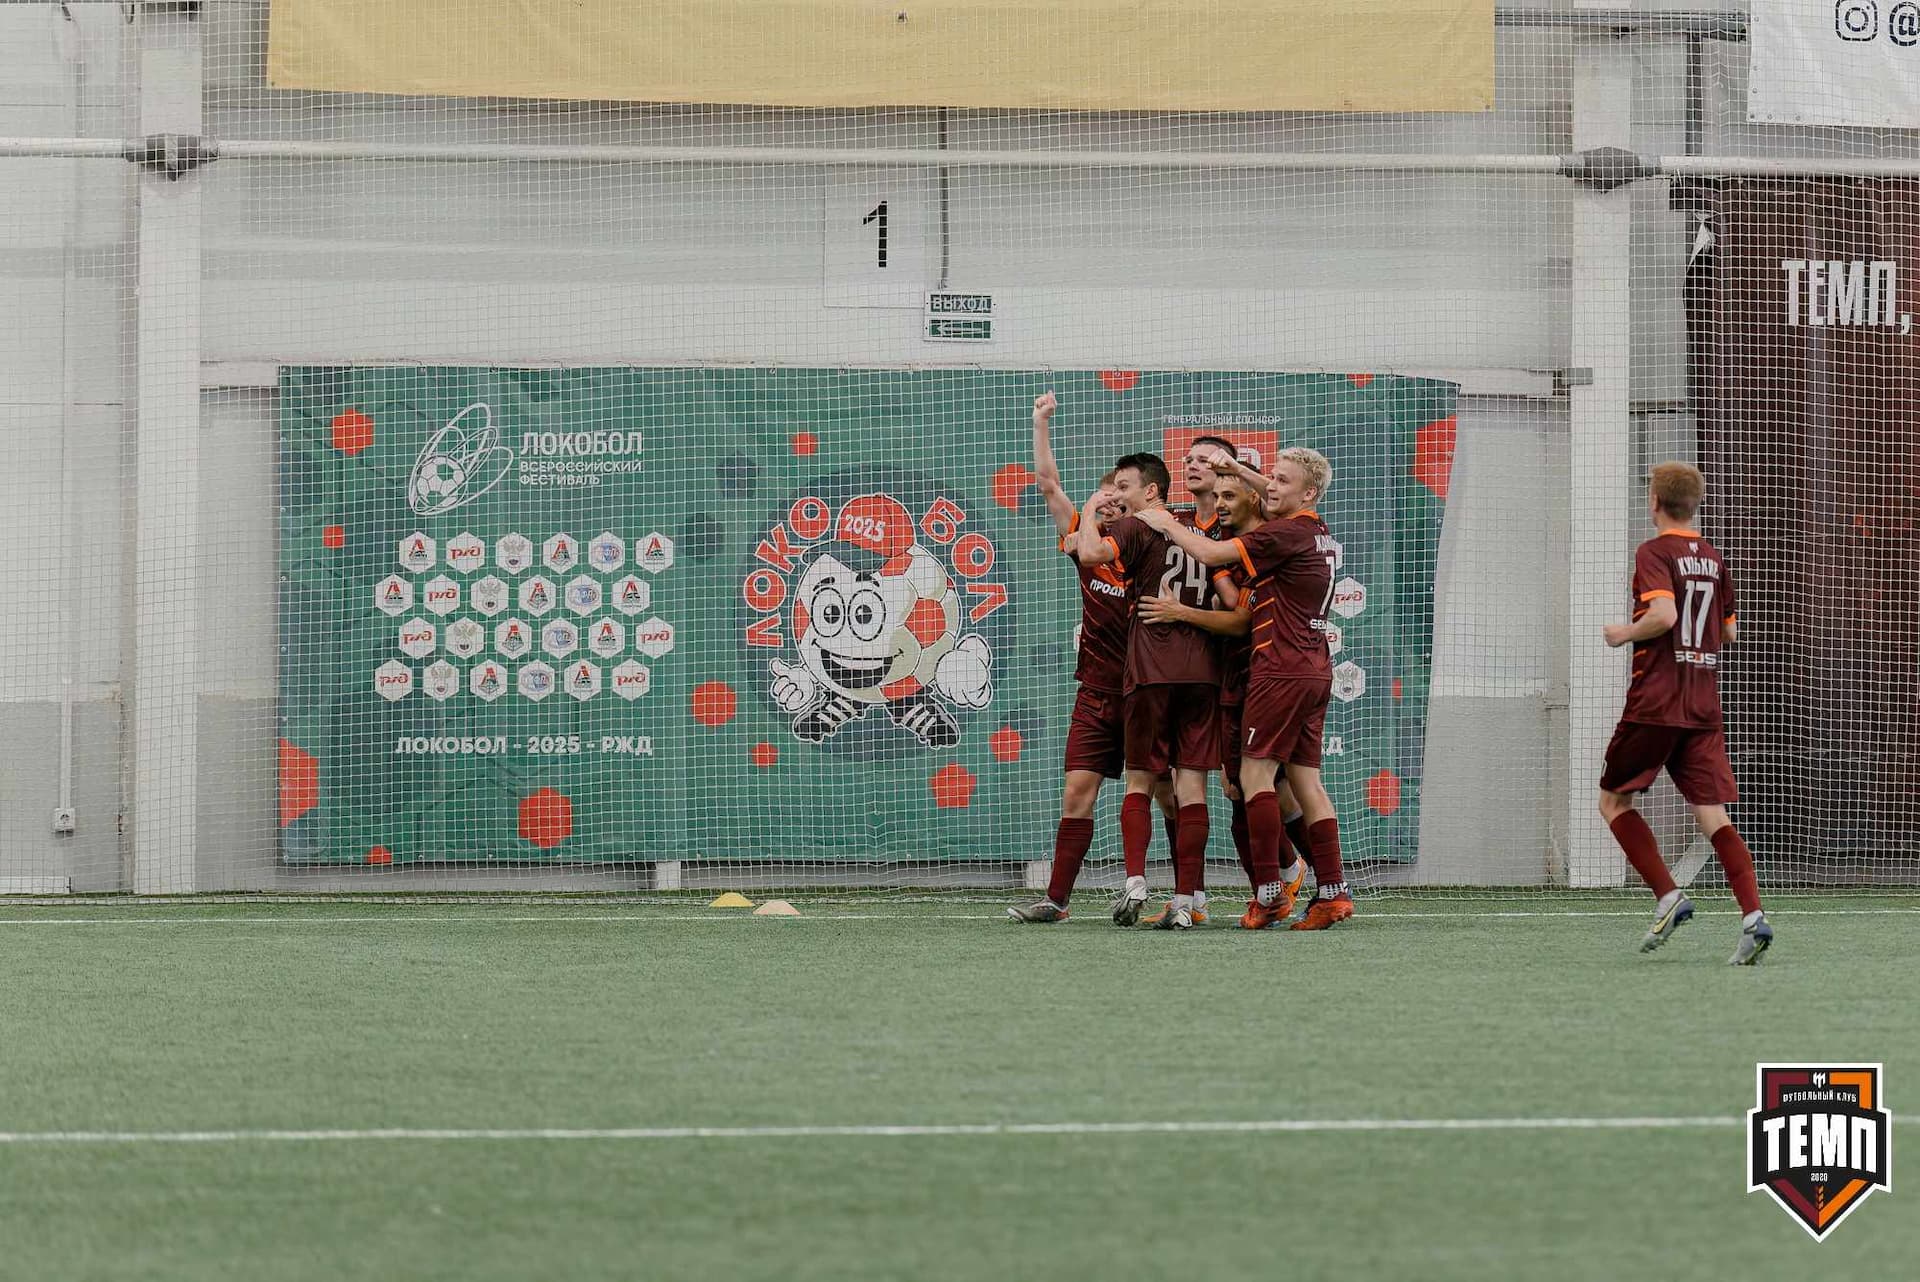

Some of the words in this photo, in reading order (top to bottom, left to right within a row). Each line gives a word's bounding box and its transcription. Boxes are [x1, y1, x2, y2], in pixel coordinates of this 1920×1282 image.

[863, 200, 887, 267] 1
[932, 296, 989, 311] ВЫХОД
[1782, 260, 1910, 335] ТЕМП,
[520, 431, 642, 456] ЛОКОБОЛ
[520, 459, 642, 472] ВСЕРОССИЙСКИЙ
[520, 474, 600, 485] ФЕСТИВАЛЬ
[844, 515, 886, 542] 2025
[1158, 544, 1208, 606] 24
[1318, 556, 1335, 616] 7
[1682, 580, 1714, 648] 17
[396, 736, 506, 754] ЛОКОБОЛ
[527, 736, 580, 754] 2025
[602, 736, 653, 756] РЖД
[1247, 727, 1256, 745] 7
